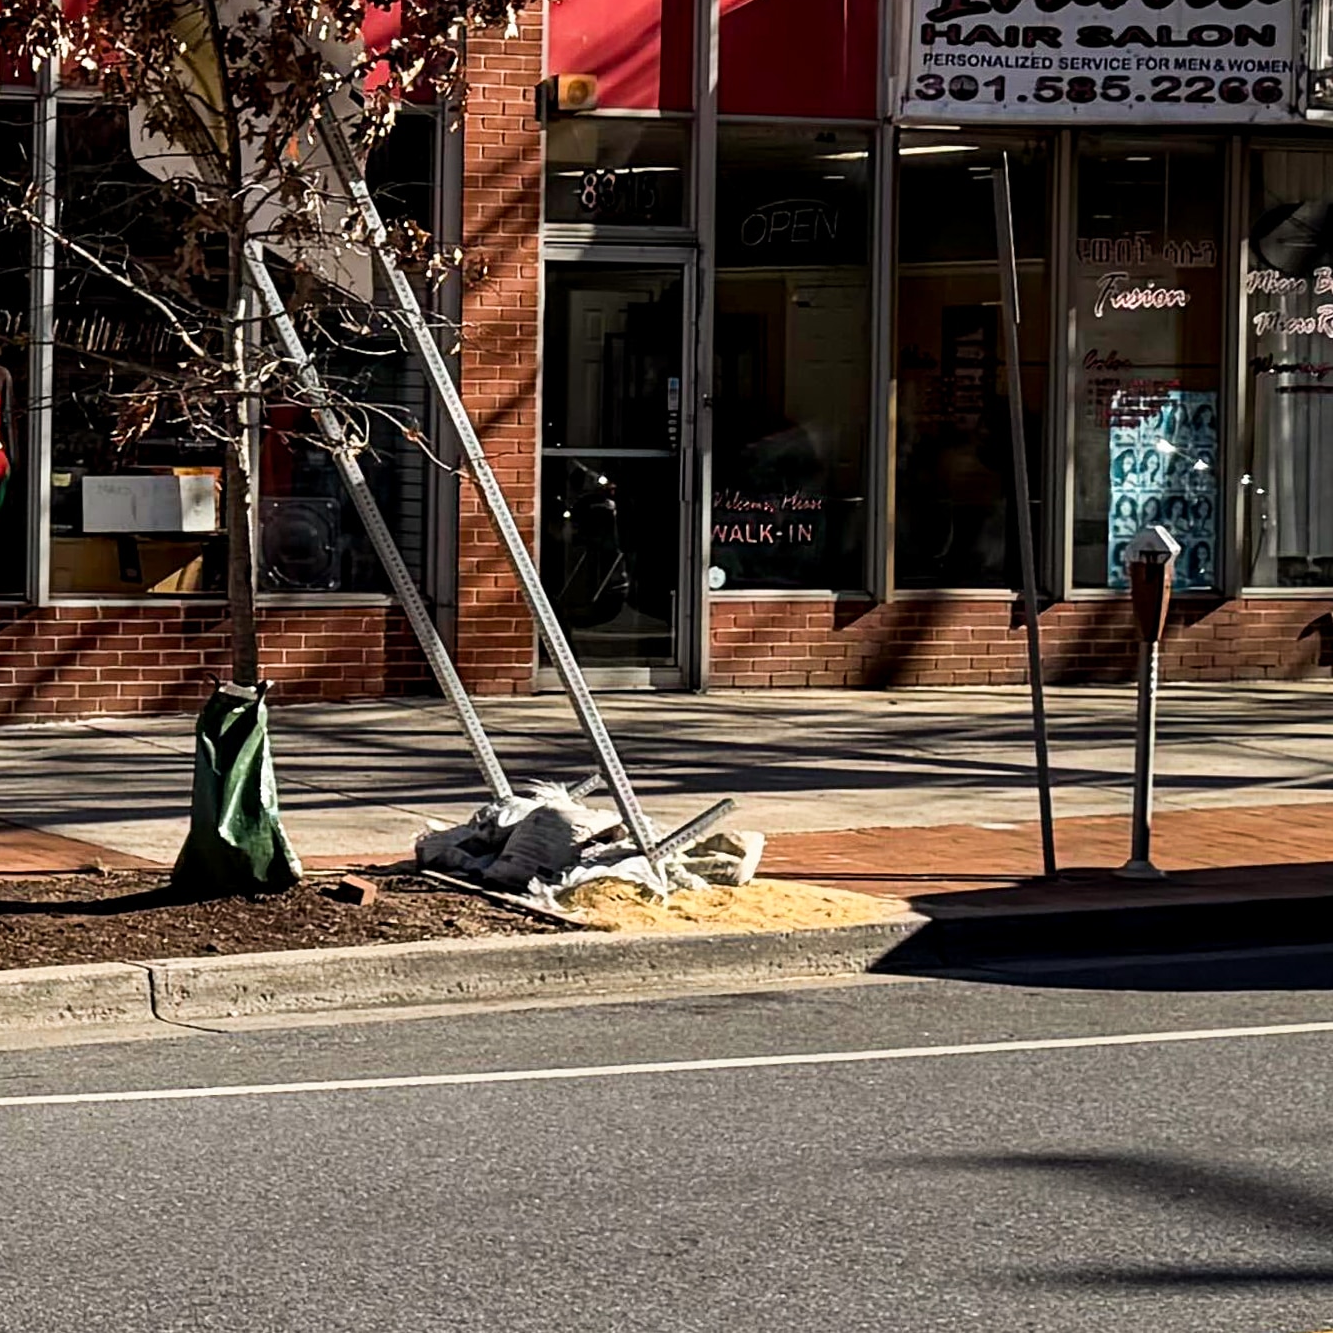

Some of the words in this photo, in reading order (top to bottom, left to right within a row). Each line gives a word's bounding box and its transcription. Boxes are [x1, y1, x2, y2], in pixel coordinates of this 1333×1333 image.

[920, 23, 1063, 48] HAIR
[1075, 23, 1277, 49] SALON
[922, 52, 1054, 71] PERSONALIZED
[1058, 56, 1132, 72] SERVICE
[1136, 57, 1170, 72] FOR
[1173, 58, 1212, 73] MEN
[1214, 59, 1226, 73] &
[1227, 59, 1295, 74] WOMEN
[914, 74, 1284, 104] 301.585.2266
[741, 207, 840, 246] OPEN
[1094, 271, 1190, 318] Fusion
[711, 523, 813, 544] WALK-IN
